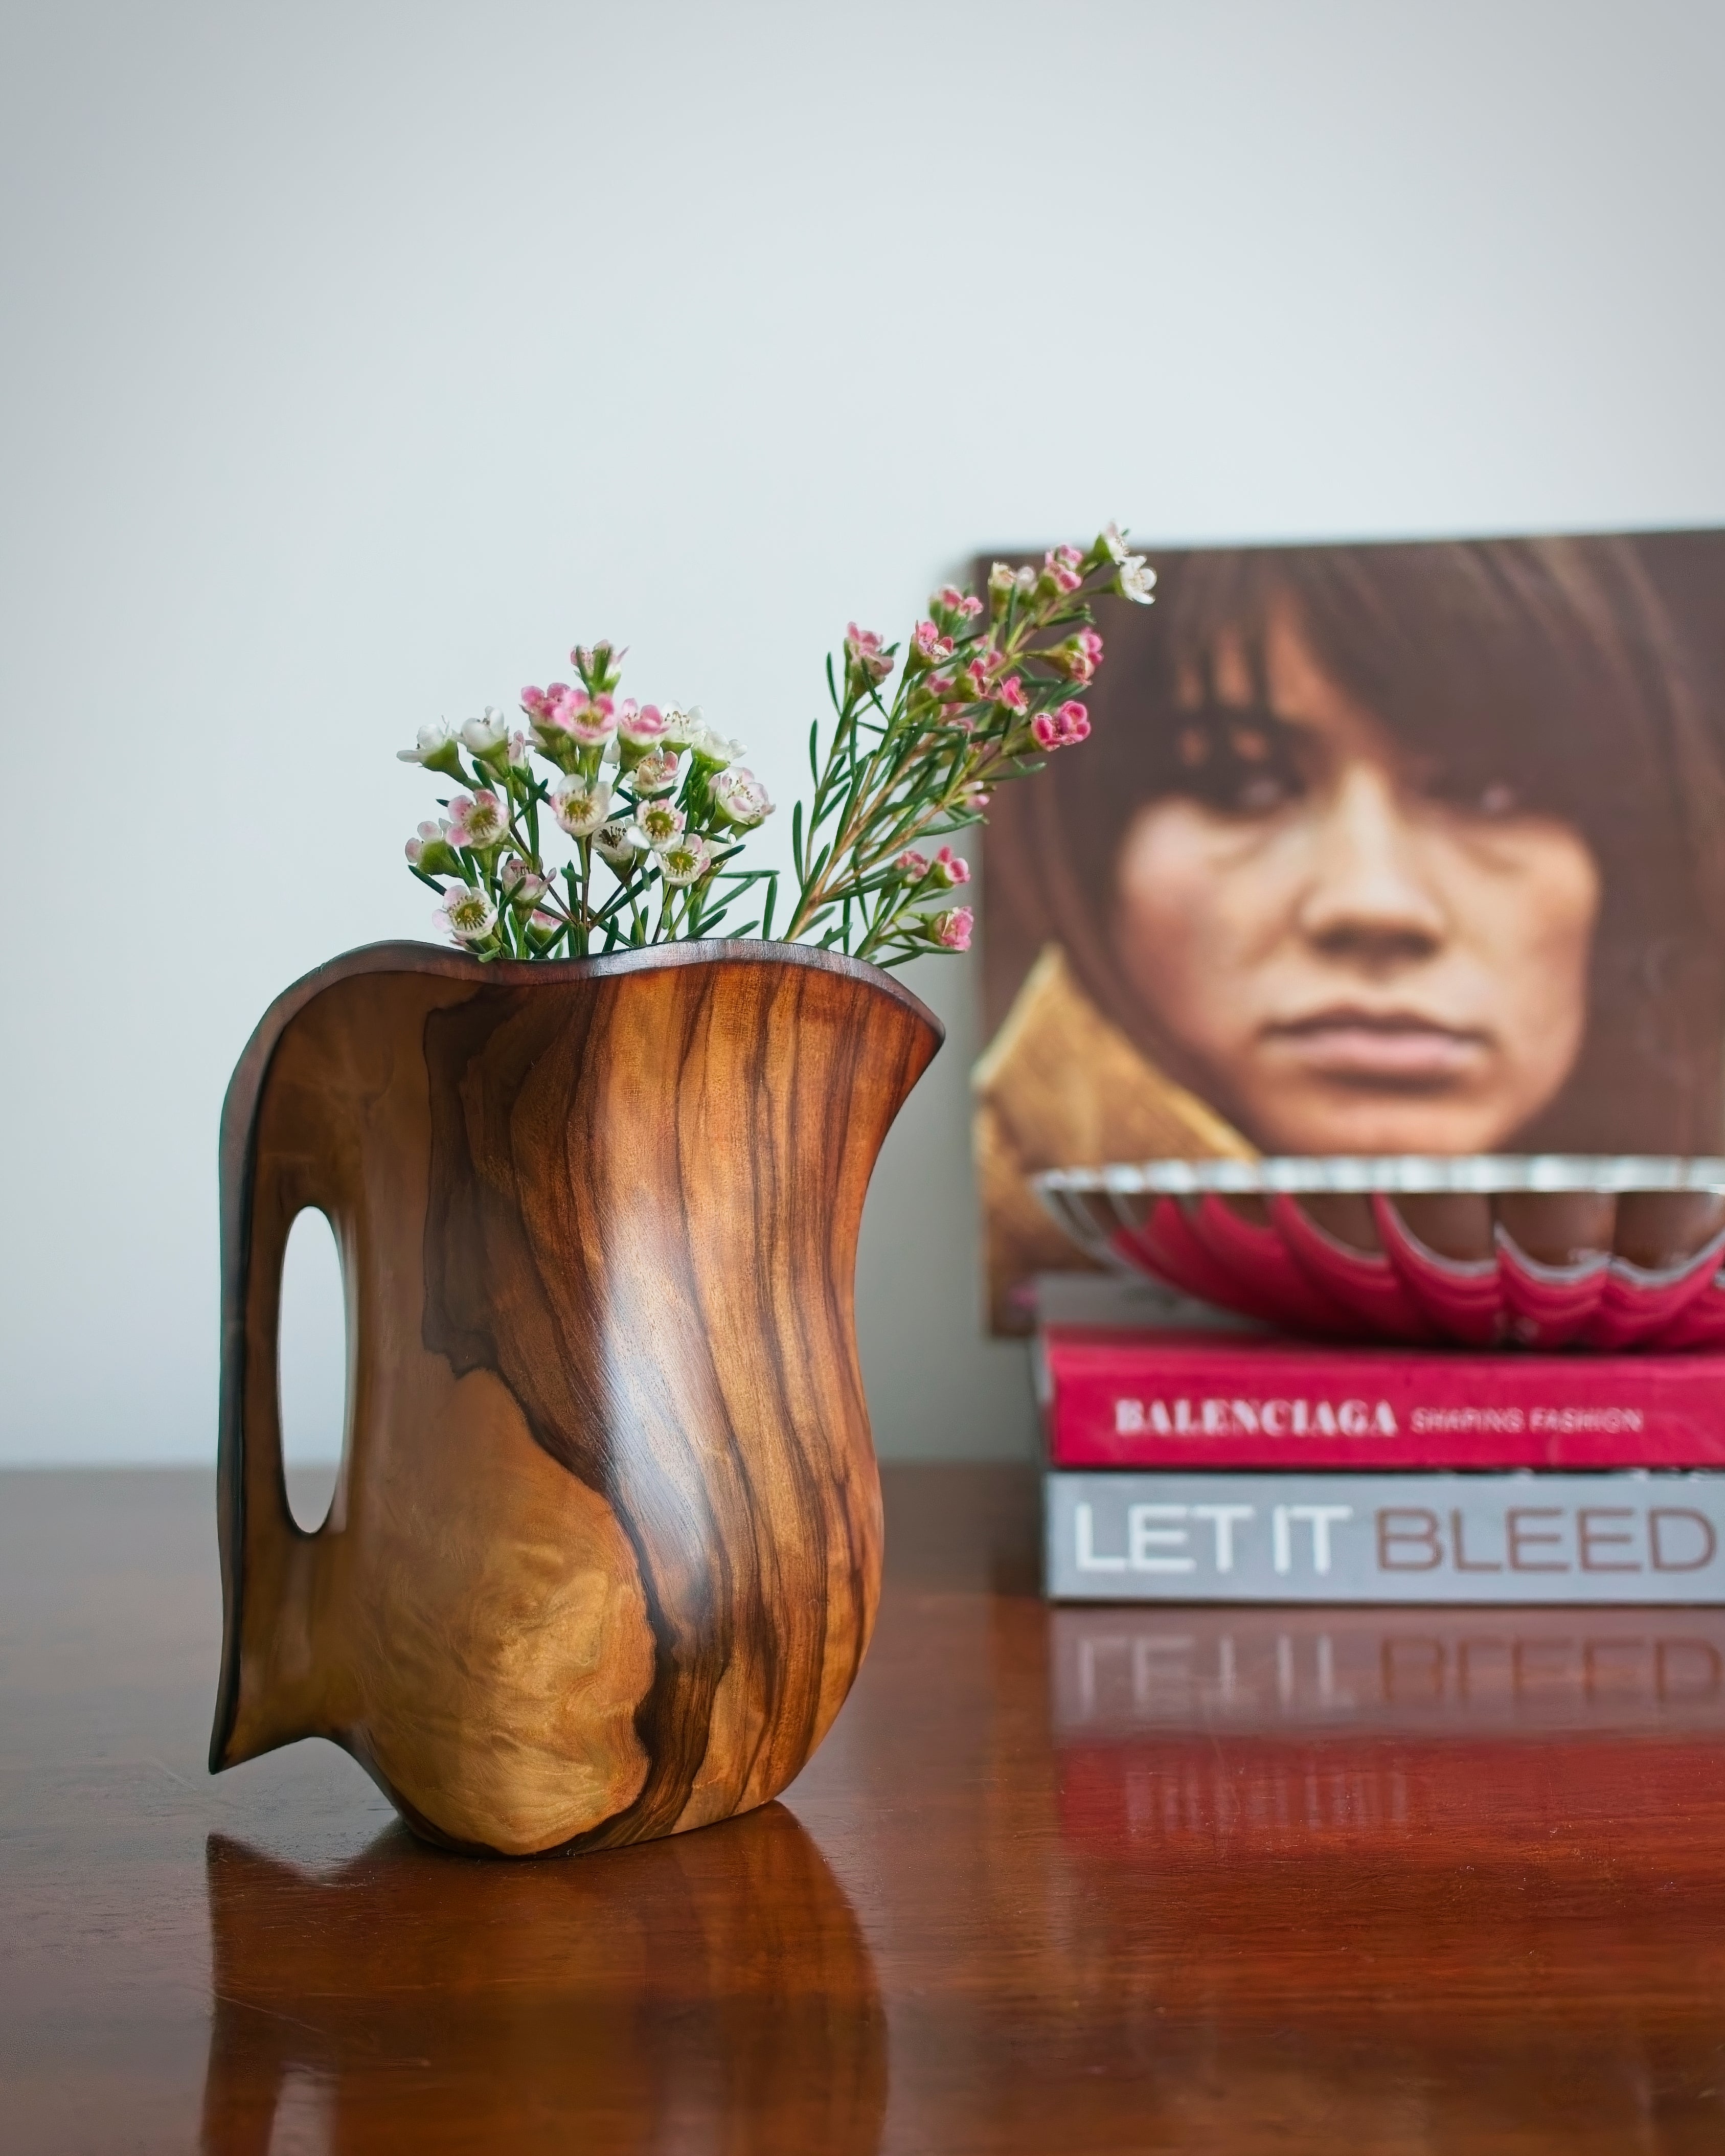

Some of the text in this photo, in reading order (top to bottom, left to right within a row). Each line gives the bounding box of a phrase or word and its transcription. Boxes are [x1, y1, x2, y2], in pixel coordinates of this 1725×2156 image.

[1115, 1398, 1398, 1437] BALENCIAGA
[1529, 1406, 1643, 1433] FASHION
[1074, 1503, 1717, 1575] LET IT BLEED
